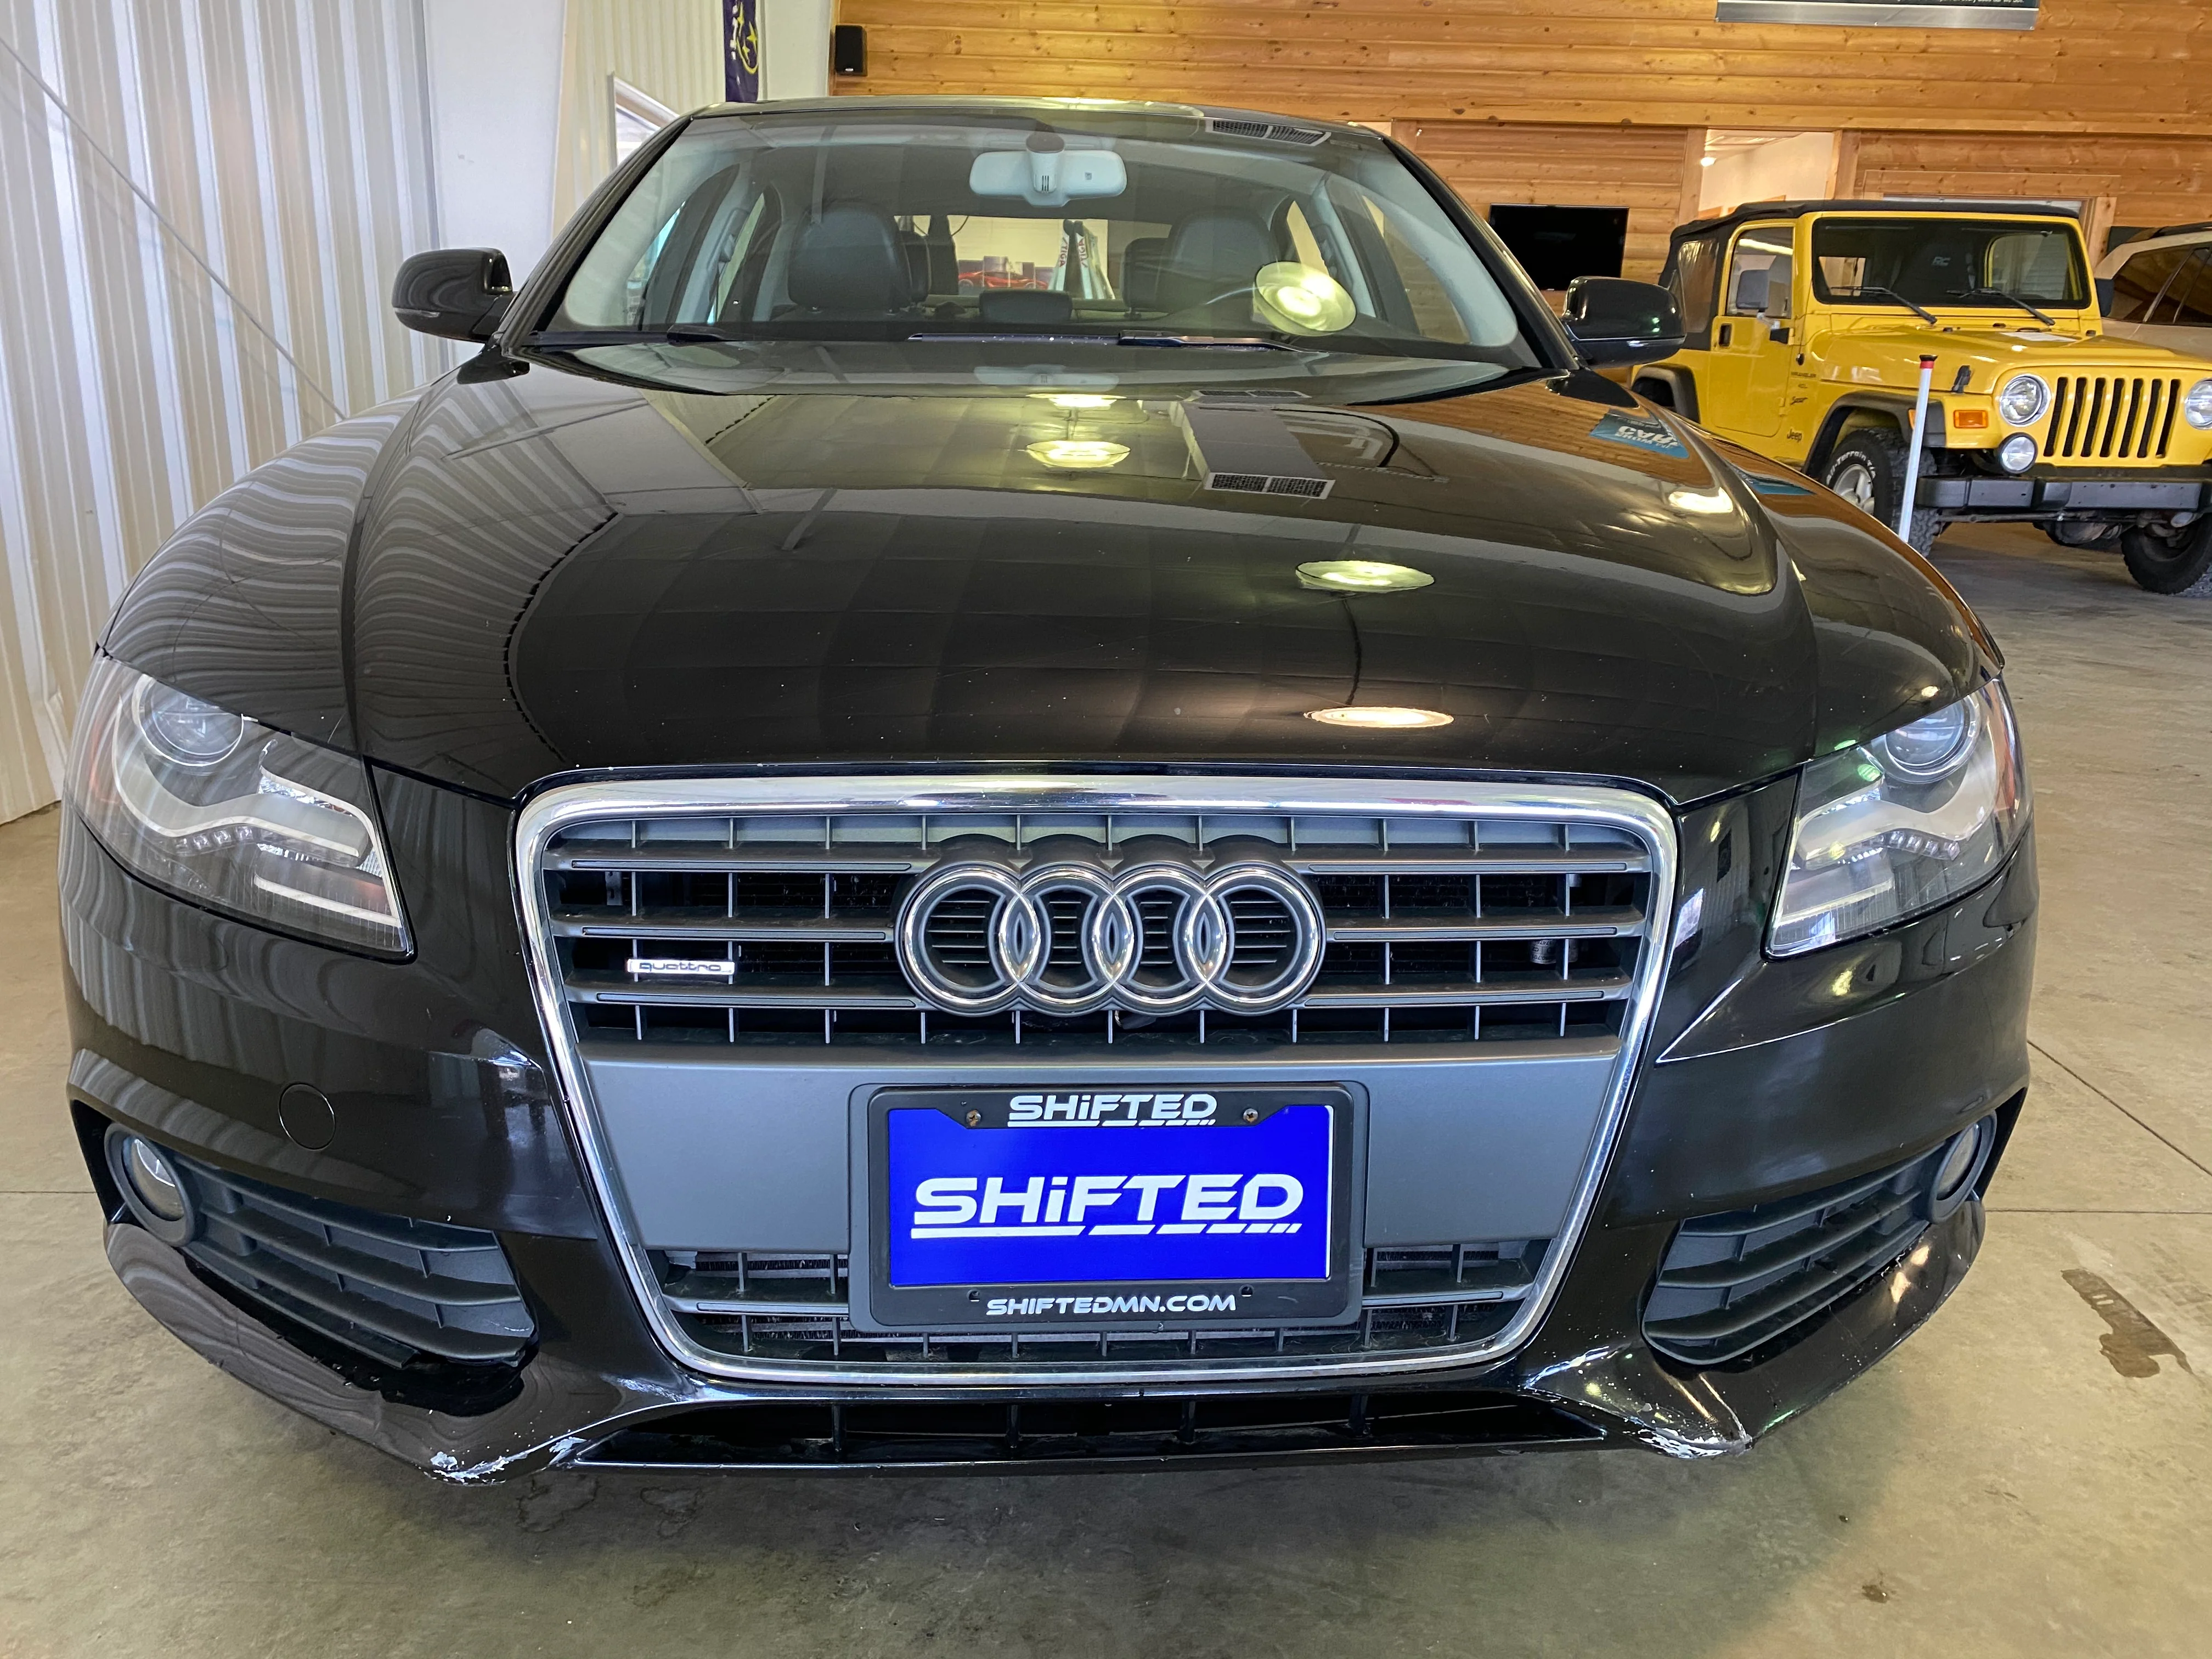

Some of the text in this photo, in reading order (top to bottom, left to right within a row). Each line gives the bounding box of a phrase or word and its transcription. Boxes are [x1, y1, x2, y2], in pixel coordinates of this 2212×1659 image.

[1787, 428, 1802, 443] Jeep
[639, 962, 722, 972] quattro
[986, 1294, 1236, 1316] SHIFTEDMN.COM
